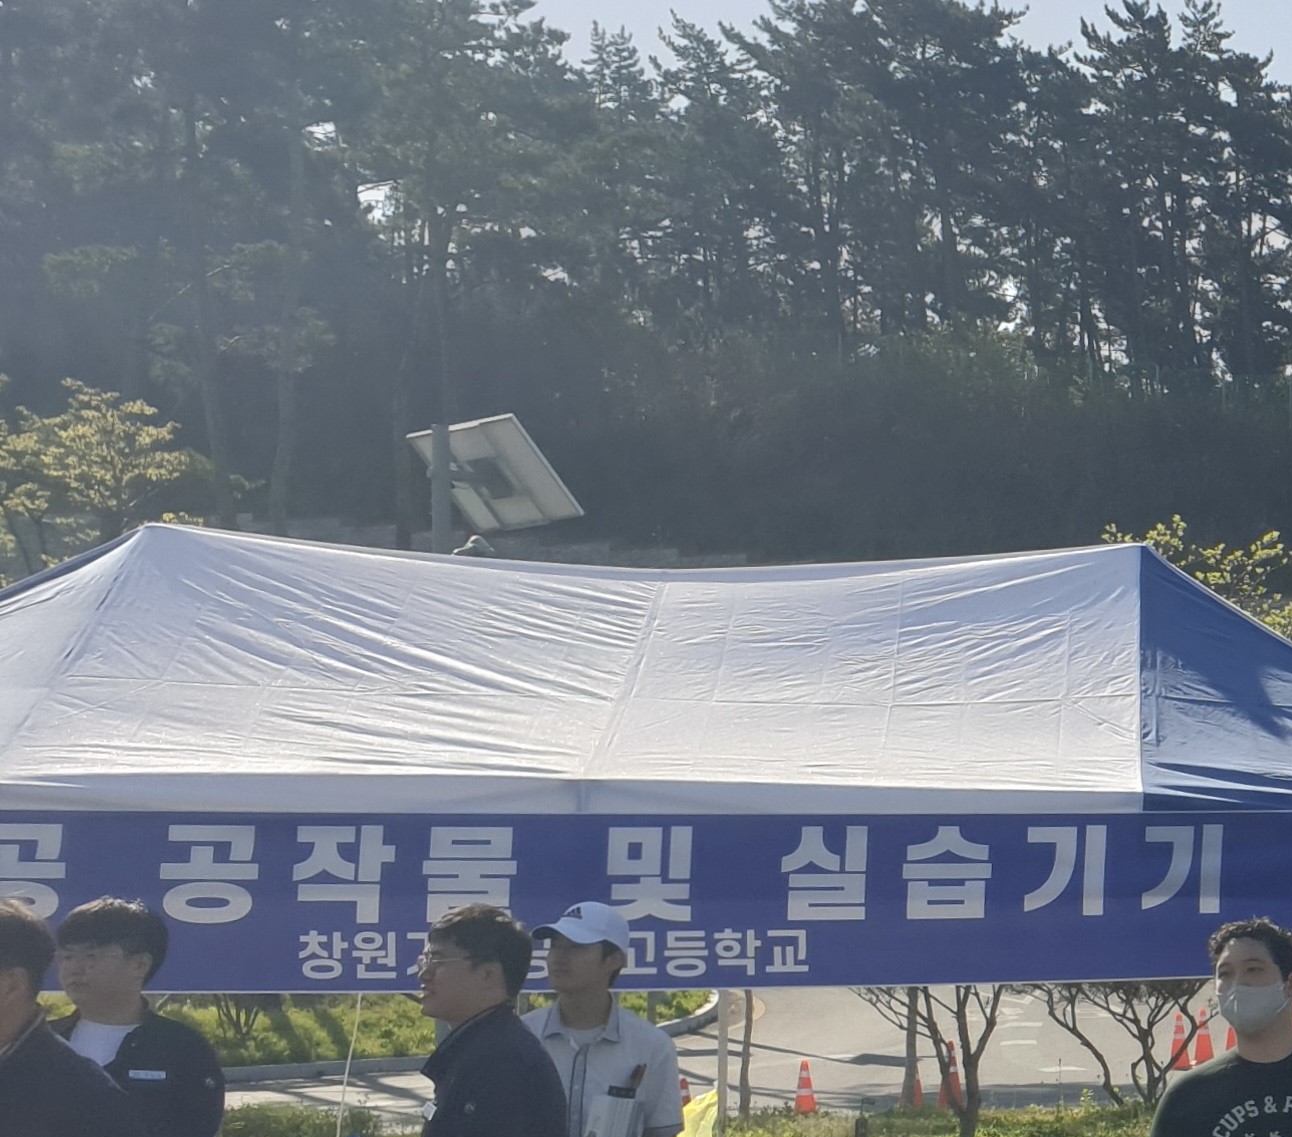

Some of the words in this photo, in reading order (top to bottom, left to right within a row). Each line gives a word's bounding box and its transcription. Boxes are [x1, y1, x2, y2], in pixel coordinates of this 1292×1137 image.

[160, 824, 518, 924] 공작물
[607, 825, 694, 922] 및
[781, 824, 1225, 921] 실습기기
[1263, 1095, 1278, 1114] &
